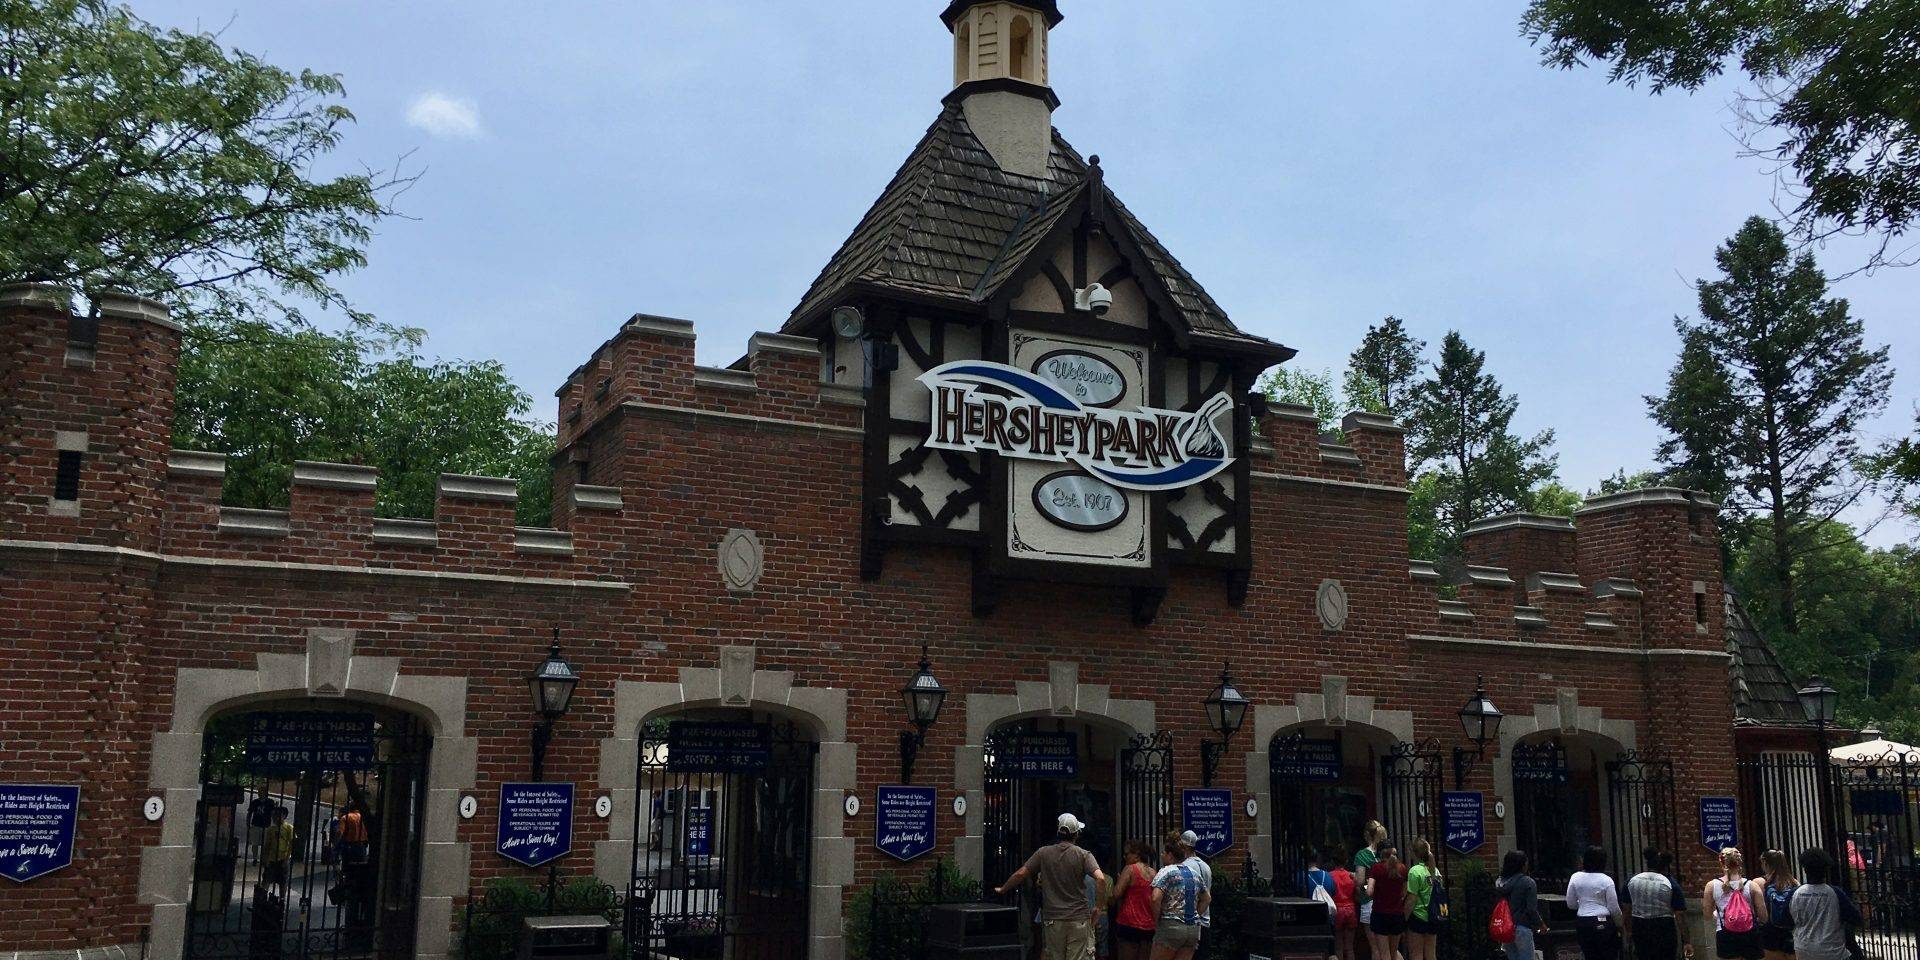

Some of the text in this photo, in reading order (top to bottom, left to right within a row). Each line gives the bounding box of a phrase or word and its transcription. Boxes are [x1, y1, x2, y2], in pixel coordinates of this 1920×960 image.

[1048, 360, 1114, 384] Welcome
[1075, 382, 1088, 396] to
[936, 385, 1184, 468] HERSHEYPARK
[1052, 487, 1112, 510] Est. 1907
[1040, 761, 1064, 770] HERE
[150, 803, 157, 814] 3
[465, 802, 471, 812] 4
[601, 802, 606, 811] 5
[850, 801, 855, 810] 6
[958, 802, 963, 810] 7
[17, 843, 38, 857] Sweet
